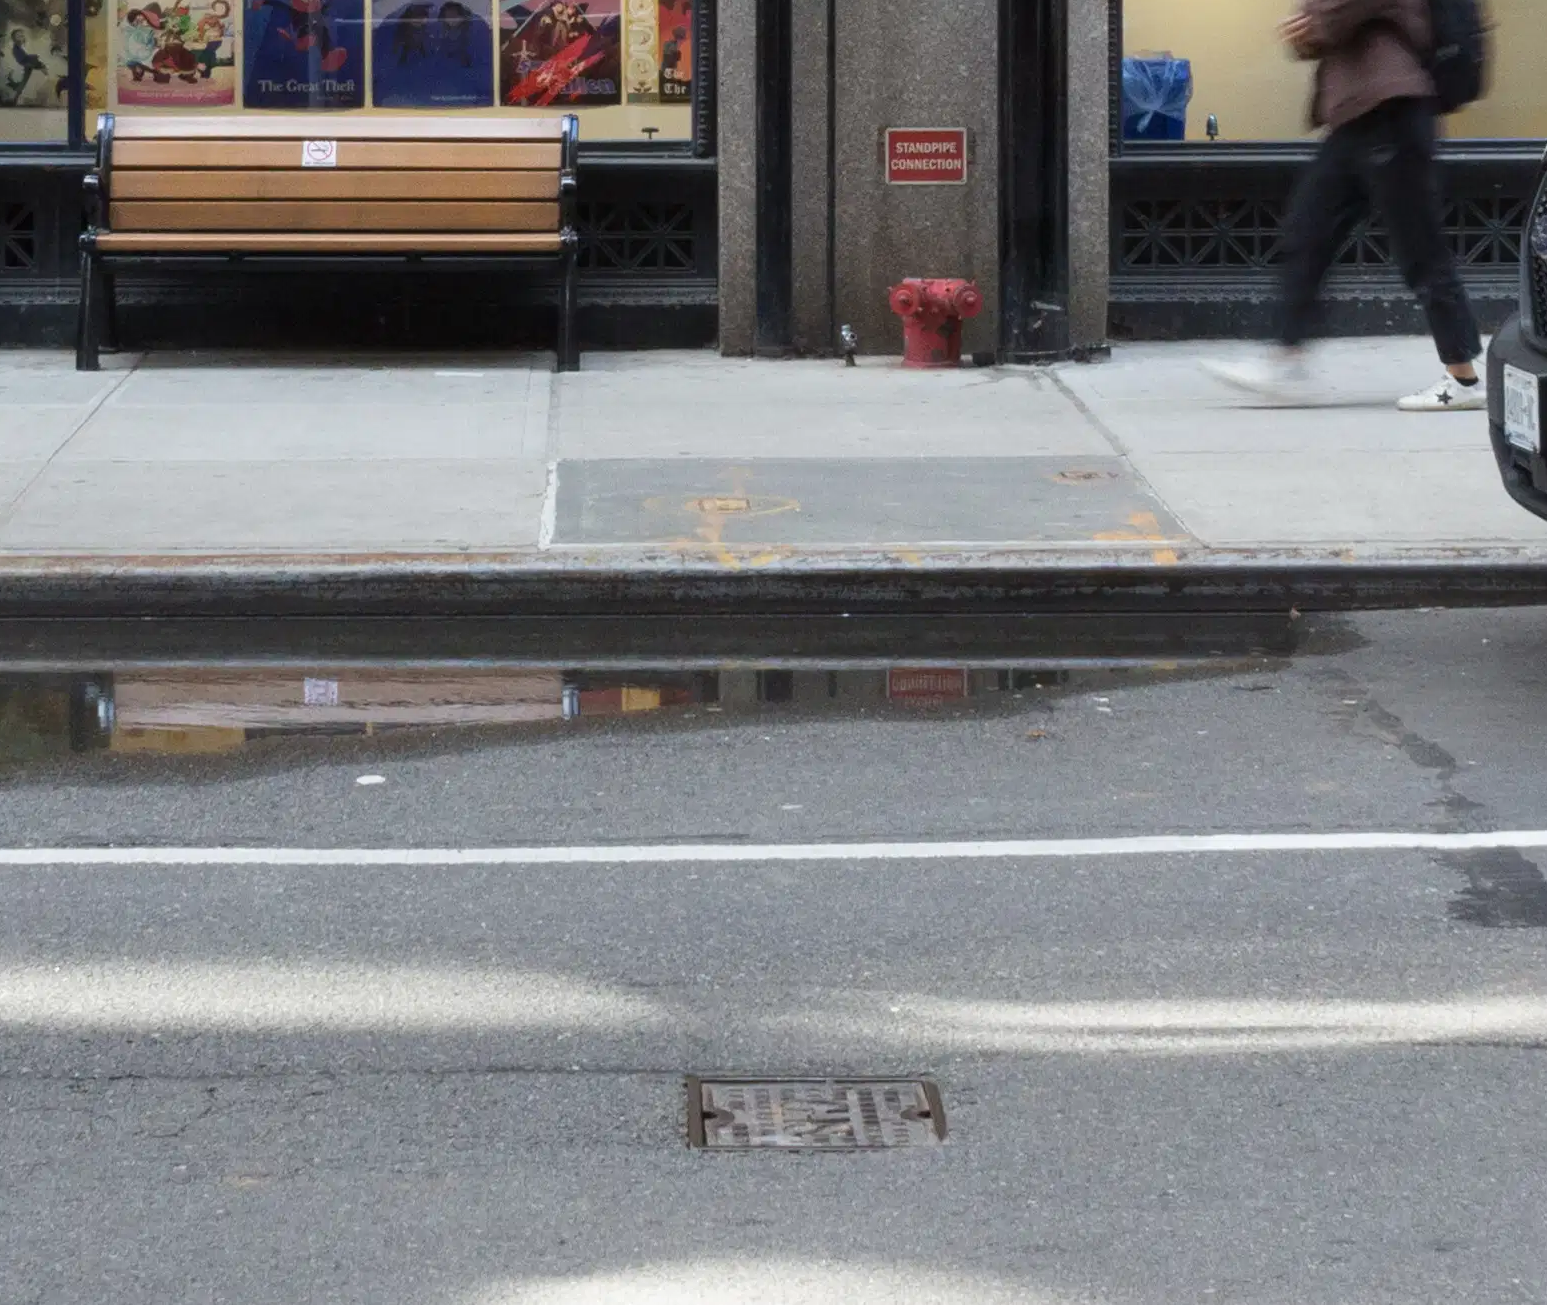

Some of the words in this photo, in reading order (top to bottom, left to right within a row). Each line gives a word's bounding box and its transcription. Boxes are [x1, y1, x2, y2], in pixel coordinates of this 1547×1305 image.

[258, 79, 284, 93] The
[286, 79, 320, 93] Great
[322, 78, 356, 93] Theft
[895, 141, 958, 154] STANDPIPE
[890, 158, 962, 171] CONNECTION
